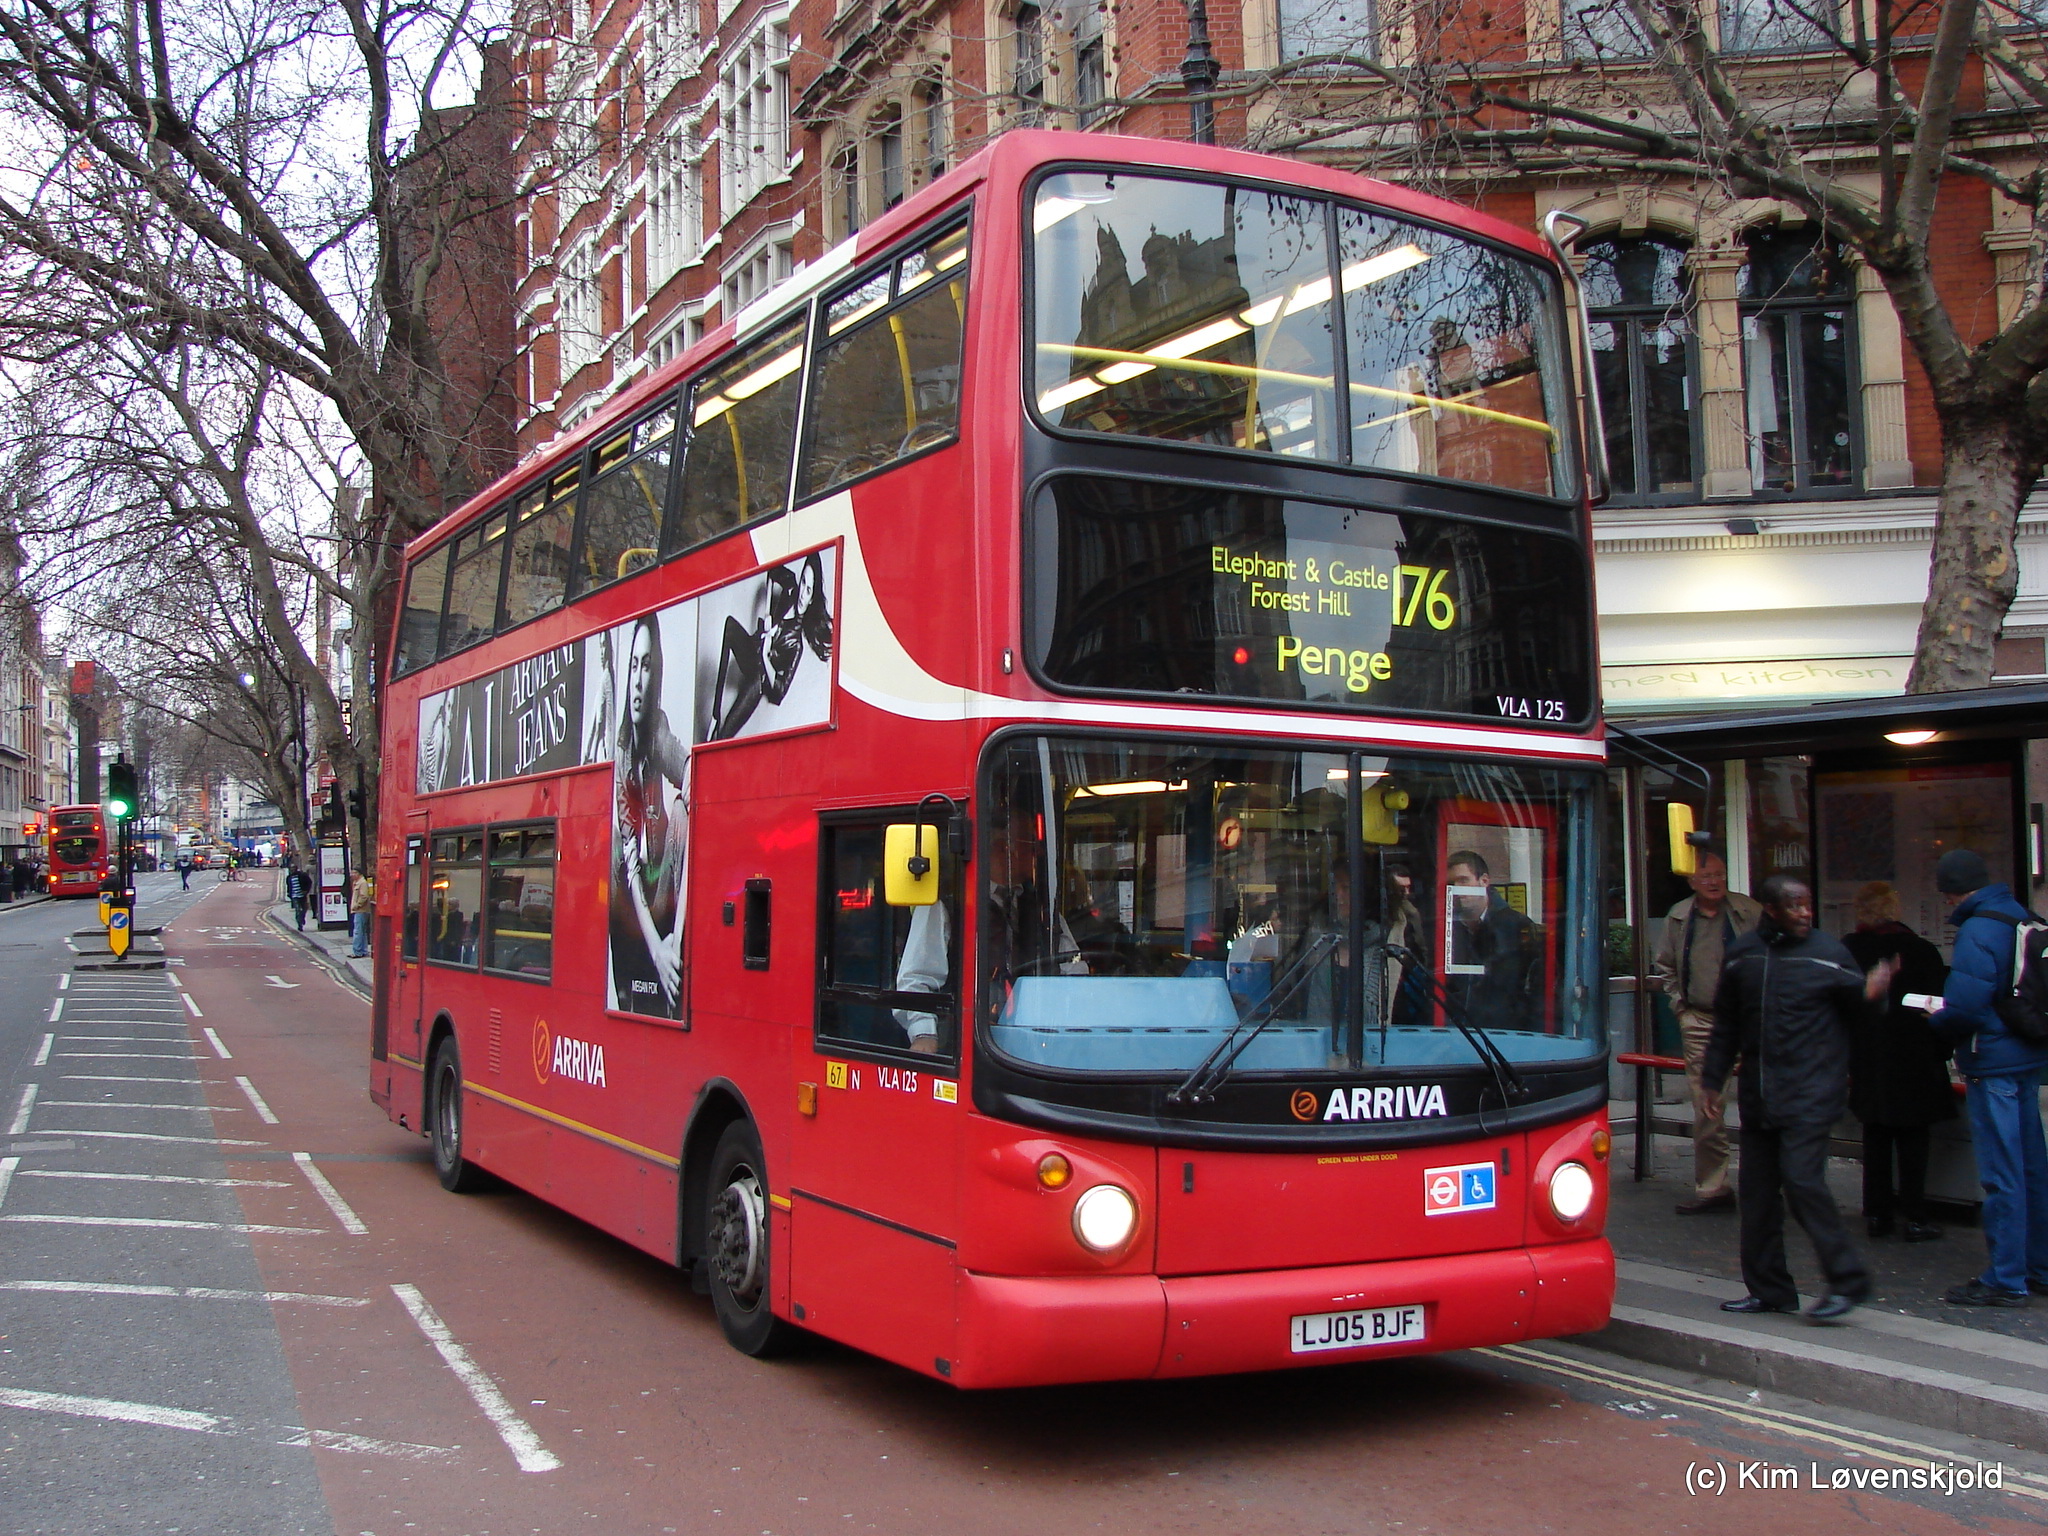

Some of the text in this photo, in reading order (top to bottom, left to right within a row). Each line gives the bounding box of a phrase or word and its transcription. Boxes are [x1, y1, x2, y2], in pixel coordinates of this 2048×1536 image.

[1212, 546, 1388, 591] Elephant & Castle
[1251, 582, 1351, 616] Forest Hill
[1392, 564, 1455, 630] 176
[1277, 635, 1391, 692] Penge
[1720, 664, 1892, 686] kitchen
[1496, 695, 1564, 721] VLA 125
[515, 681, 567, 775] JEANS
[631, 979, 659, 995] MEGAN FOX
[552, 1034, 607, 1088] ARRIVA
[830, 1065, 842, 1085] 67
[851, 1069, 861, 1090] N
[877, 1066, 900, 1090] VLA
[902, 1070, 918, 1093] 125
[1323, 1085, 1447, 1121] ARRIVA
[1317, 1157, 1341, 1165] SCREEN
[1360, 1154, 1379, 1162] UNDER
[1380, 1153, 1398, 1161] DOOR
[1302, 1309, 1415, 1345] LJ05 BJF
